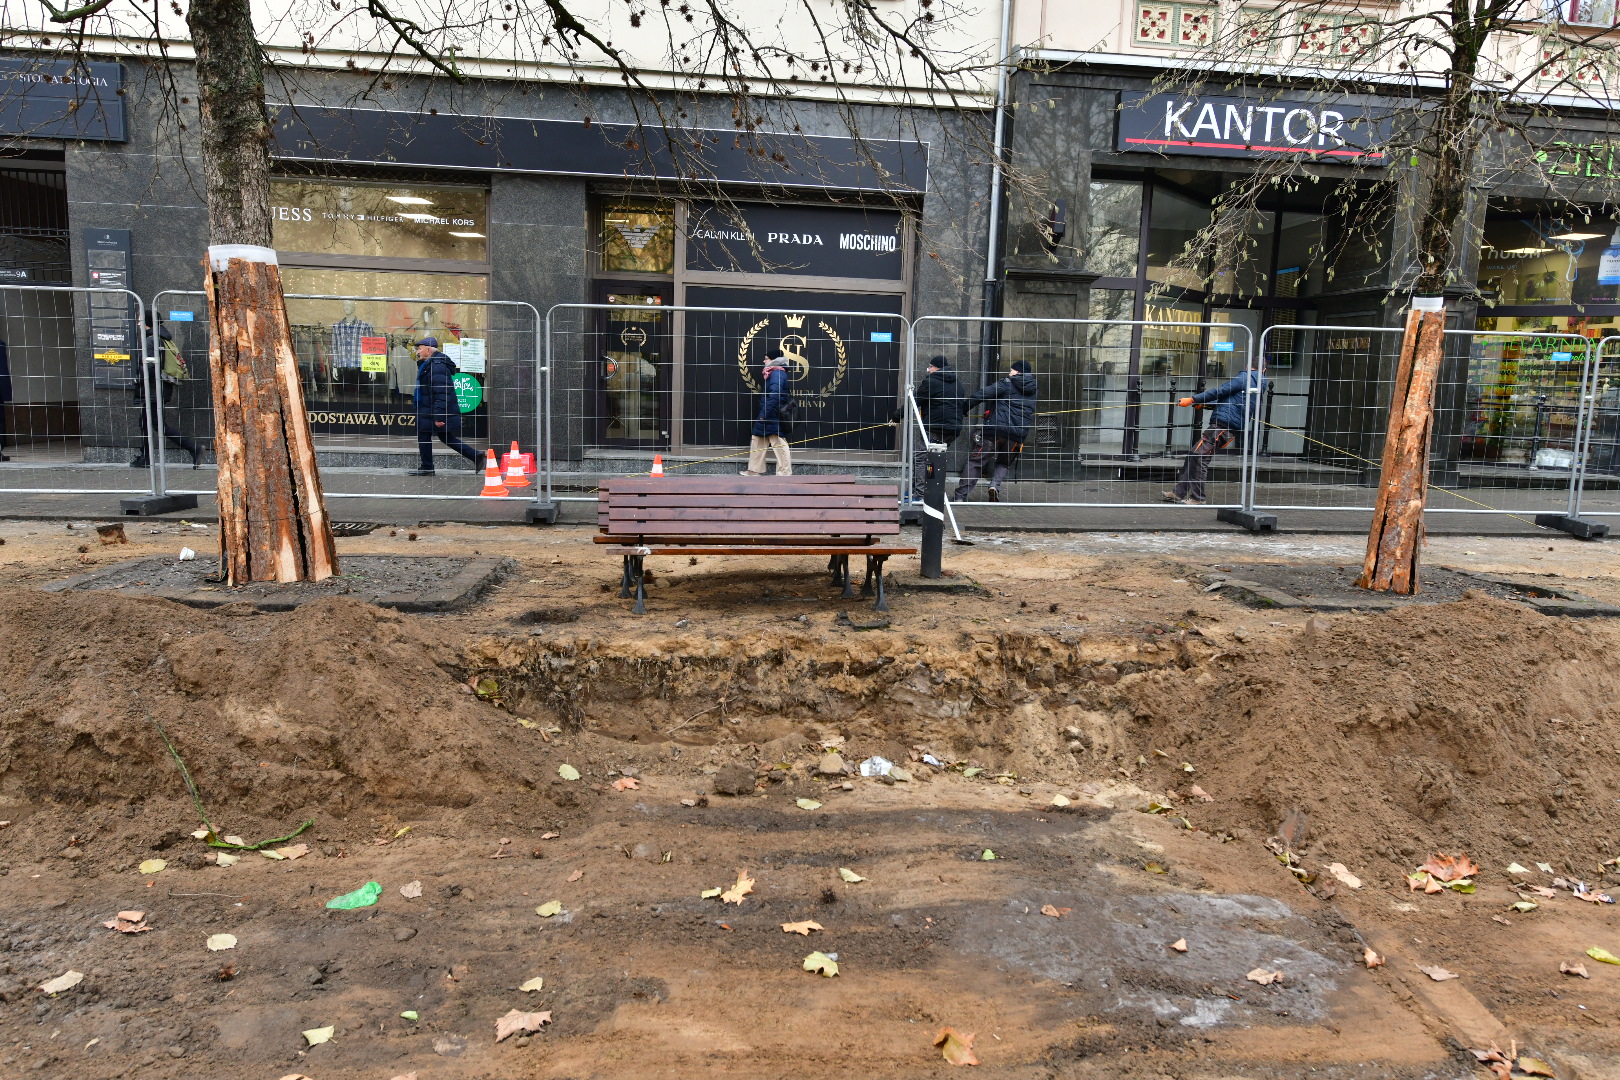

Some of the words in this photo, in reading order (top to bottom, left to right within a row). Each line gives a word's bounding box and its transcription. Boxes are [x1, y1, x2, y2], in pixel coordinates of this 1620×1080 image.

[19, 73, 108, 87] STOATLOGIA
[1164, 100, 1344, 146] KANTOR
[367, 215, 404, 223] HILFIGER
[413, 217, 450, 225] MICHAEL
[452, 219, 475, 227] KORS
[697, 229, 729, 240] CALVIN
[768, 232, 824, 246] PRADA
[839, 232, 896, 252] MOSCHINO
[15, 270, 27, 278] 9A
[1144, 303, 1202, 335] KANTOR
[1489, 336, 1601, 351] ZIELARNIA
[799, 399, 826, 408] HAND
[308, 412, 379, 425] DOSTAWA
[380, 414, 396, 426] W
